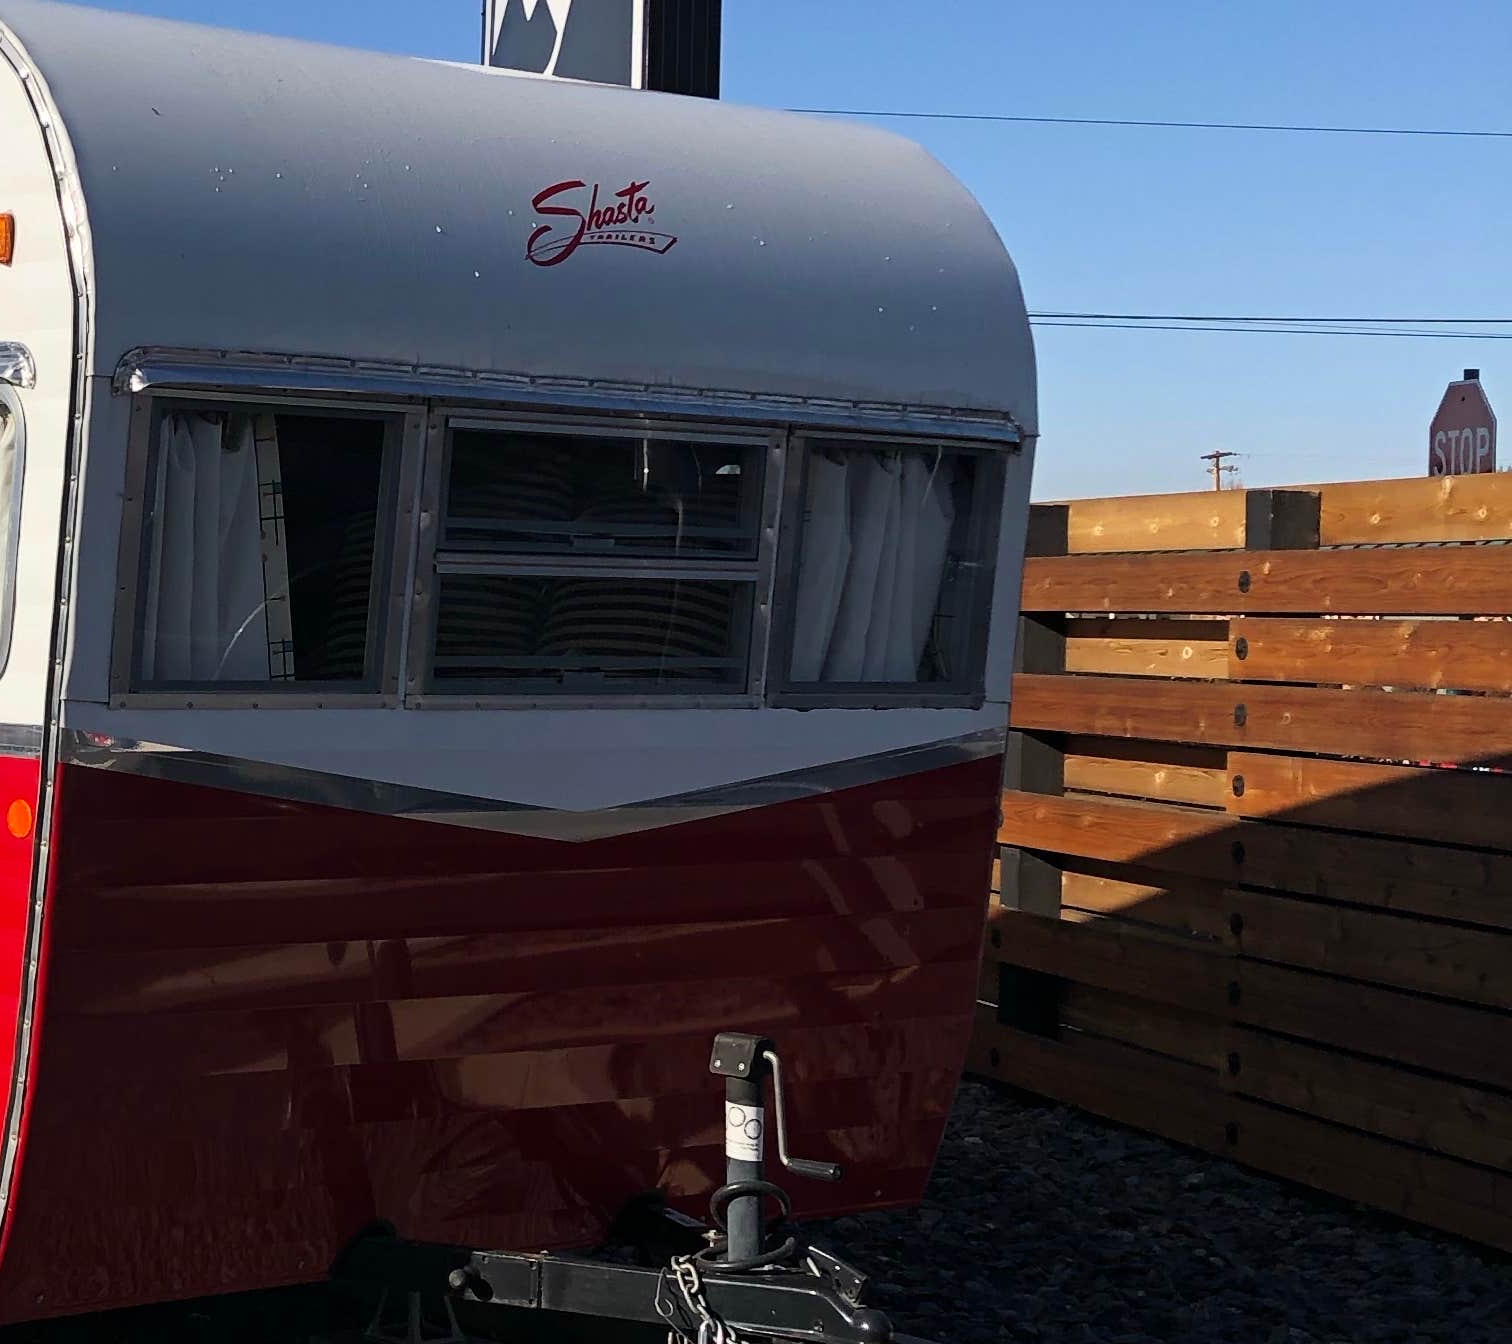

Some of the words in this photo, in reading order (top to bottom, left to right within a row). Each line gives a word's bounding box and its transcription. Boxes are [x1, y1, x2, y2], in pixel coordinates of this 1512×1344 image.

[527, 179, 656, 267] Shasta
[589, 233, 656, 245] TRAILERS
[1433, 427, 1490, 476] STOP
